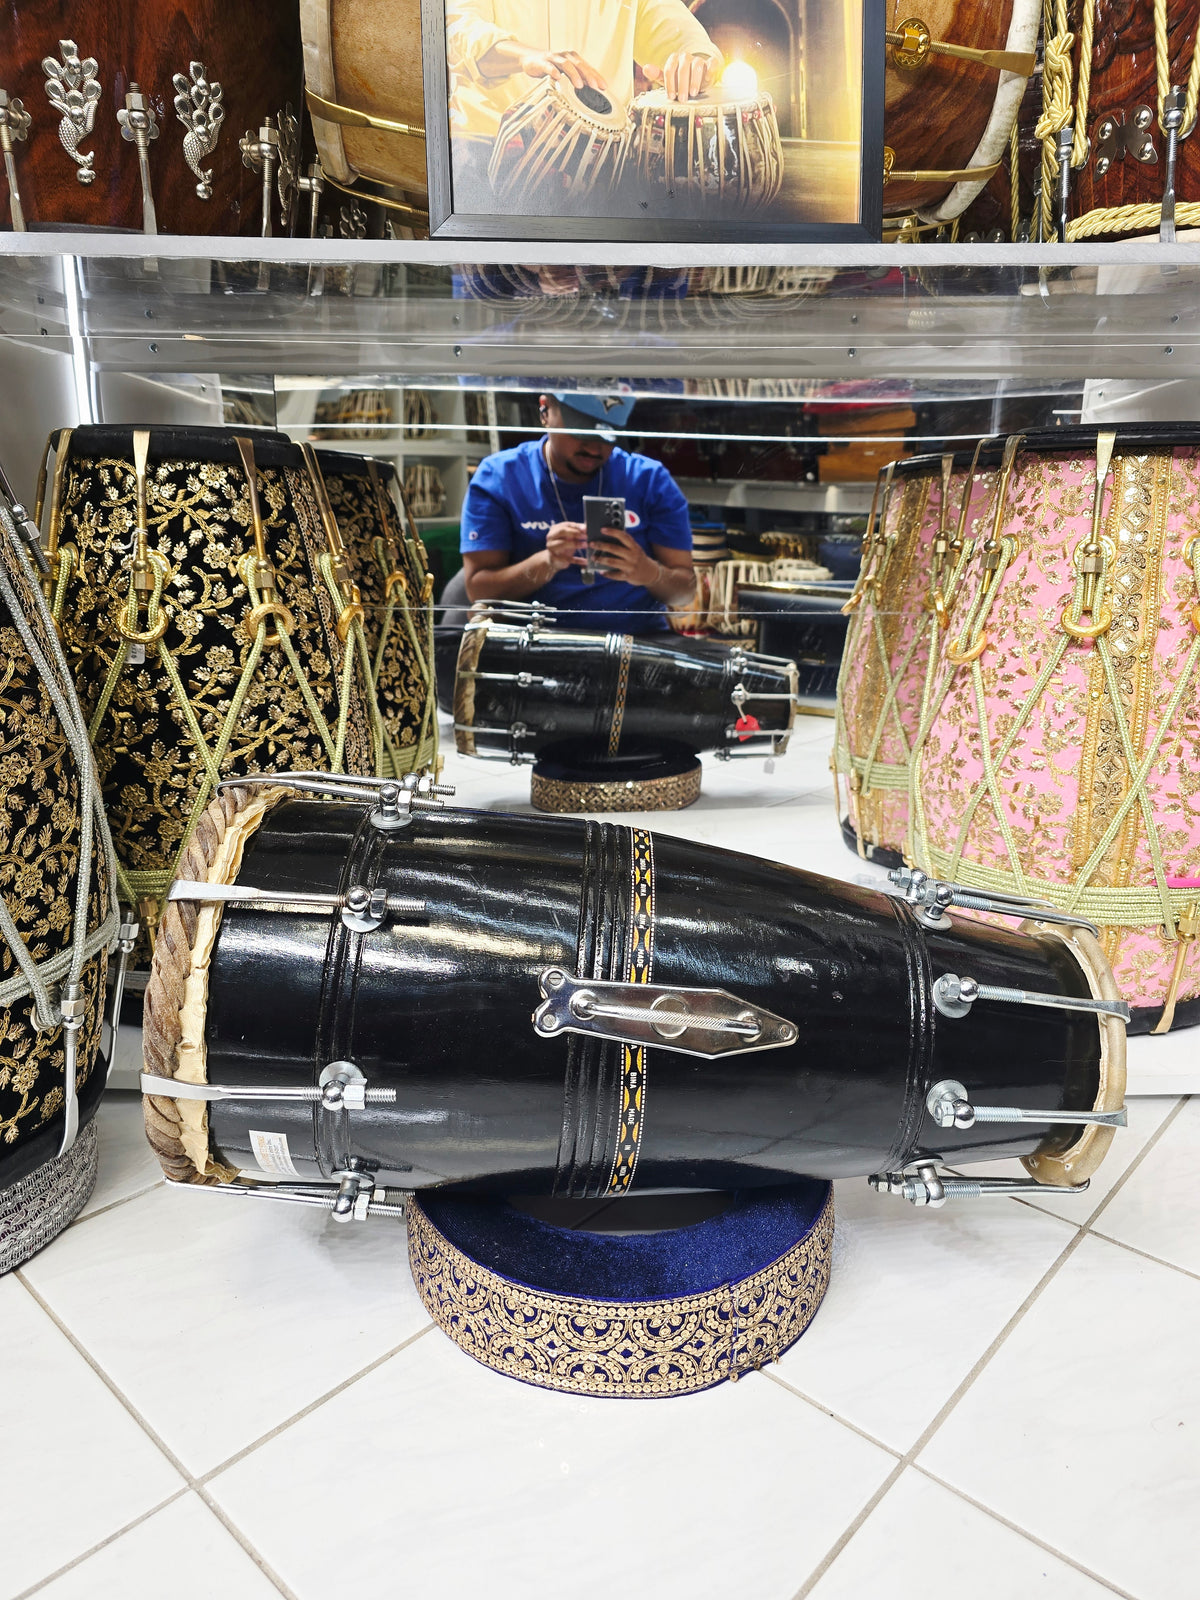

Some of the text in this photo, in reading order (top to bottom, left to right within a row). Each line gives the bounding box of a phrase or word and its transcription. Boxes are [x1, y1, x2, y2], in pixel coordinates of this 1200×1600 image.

[637, 948, 645, 968] MADE
[630, 1071, 638, 1089] BINA
[627, 1108, 636, 1126] MADE
